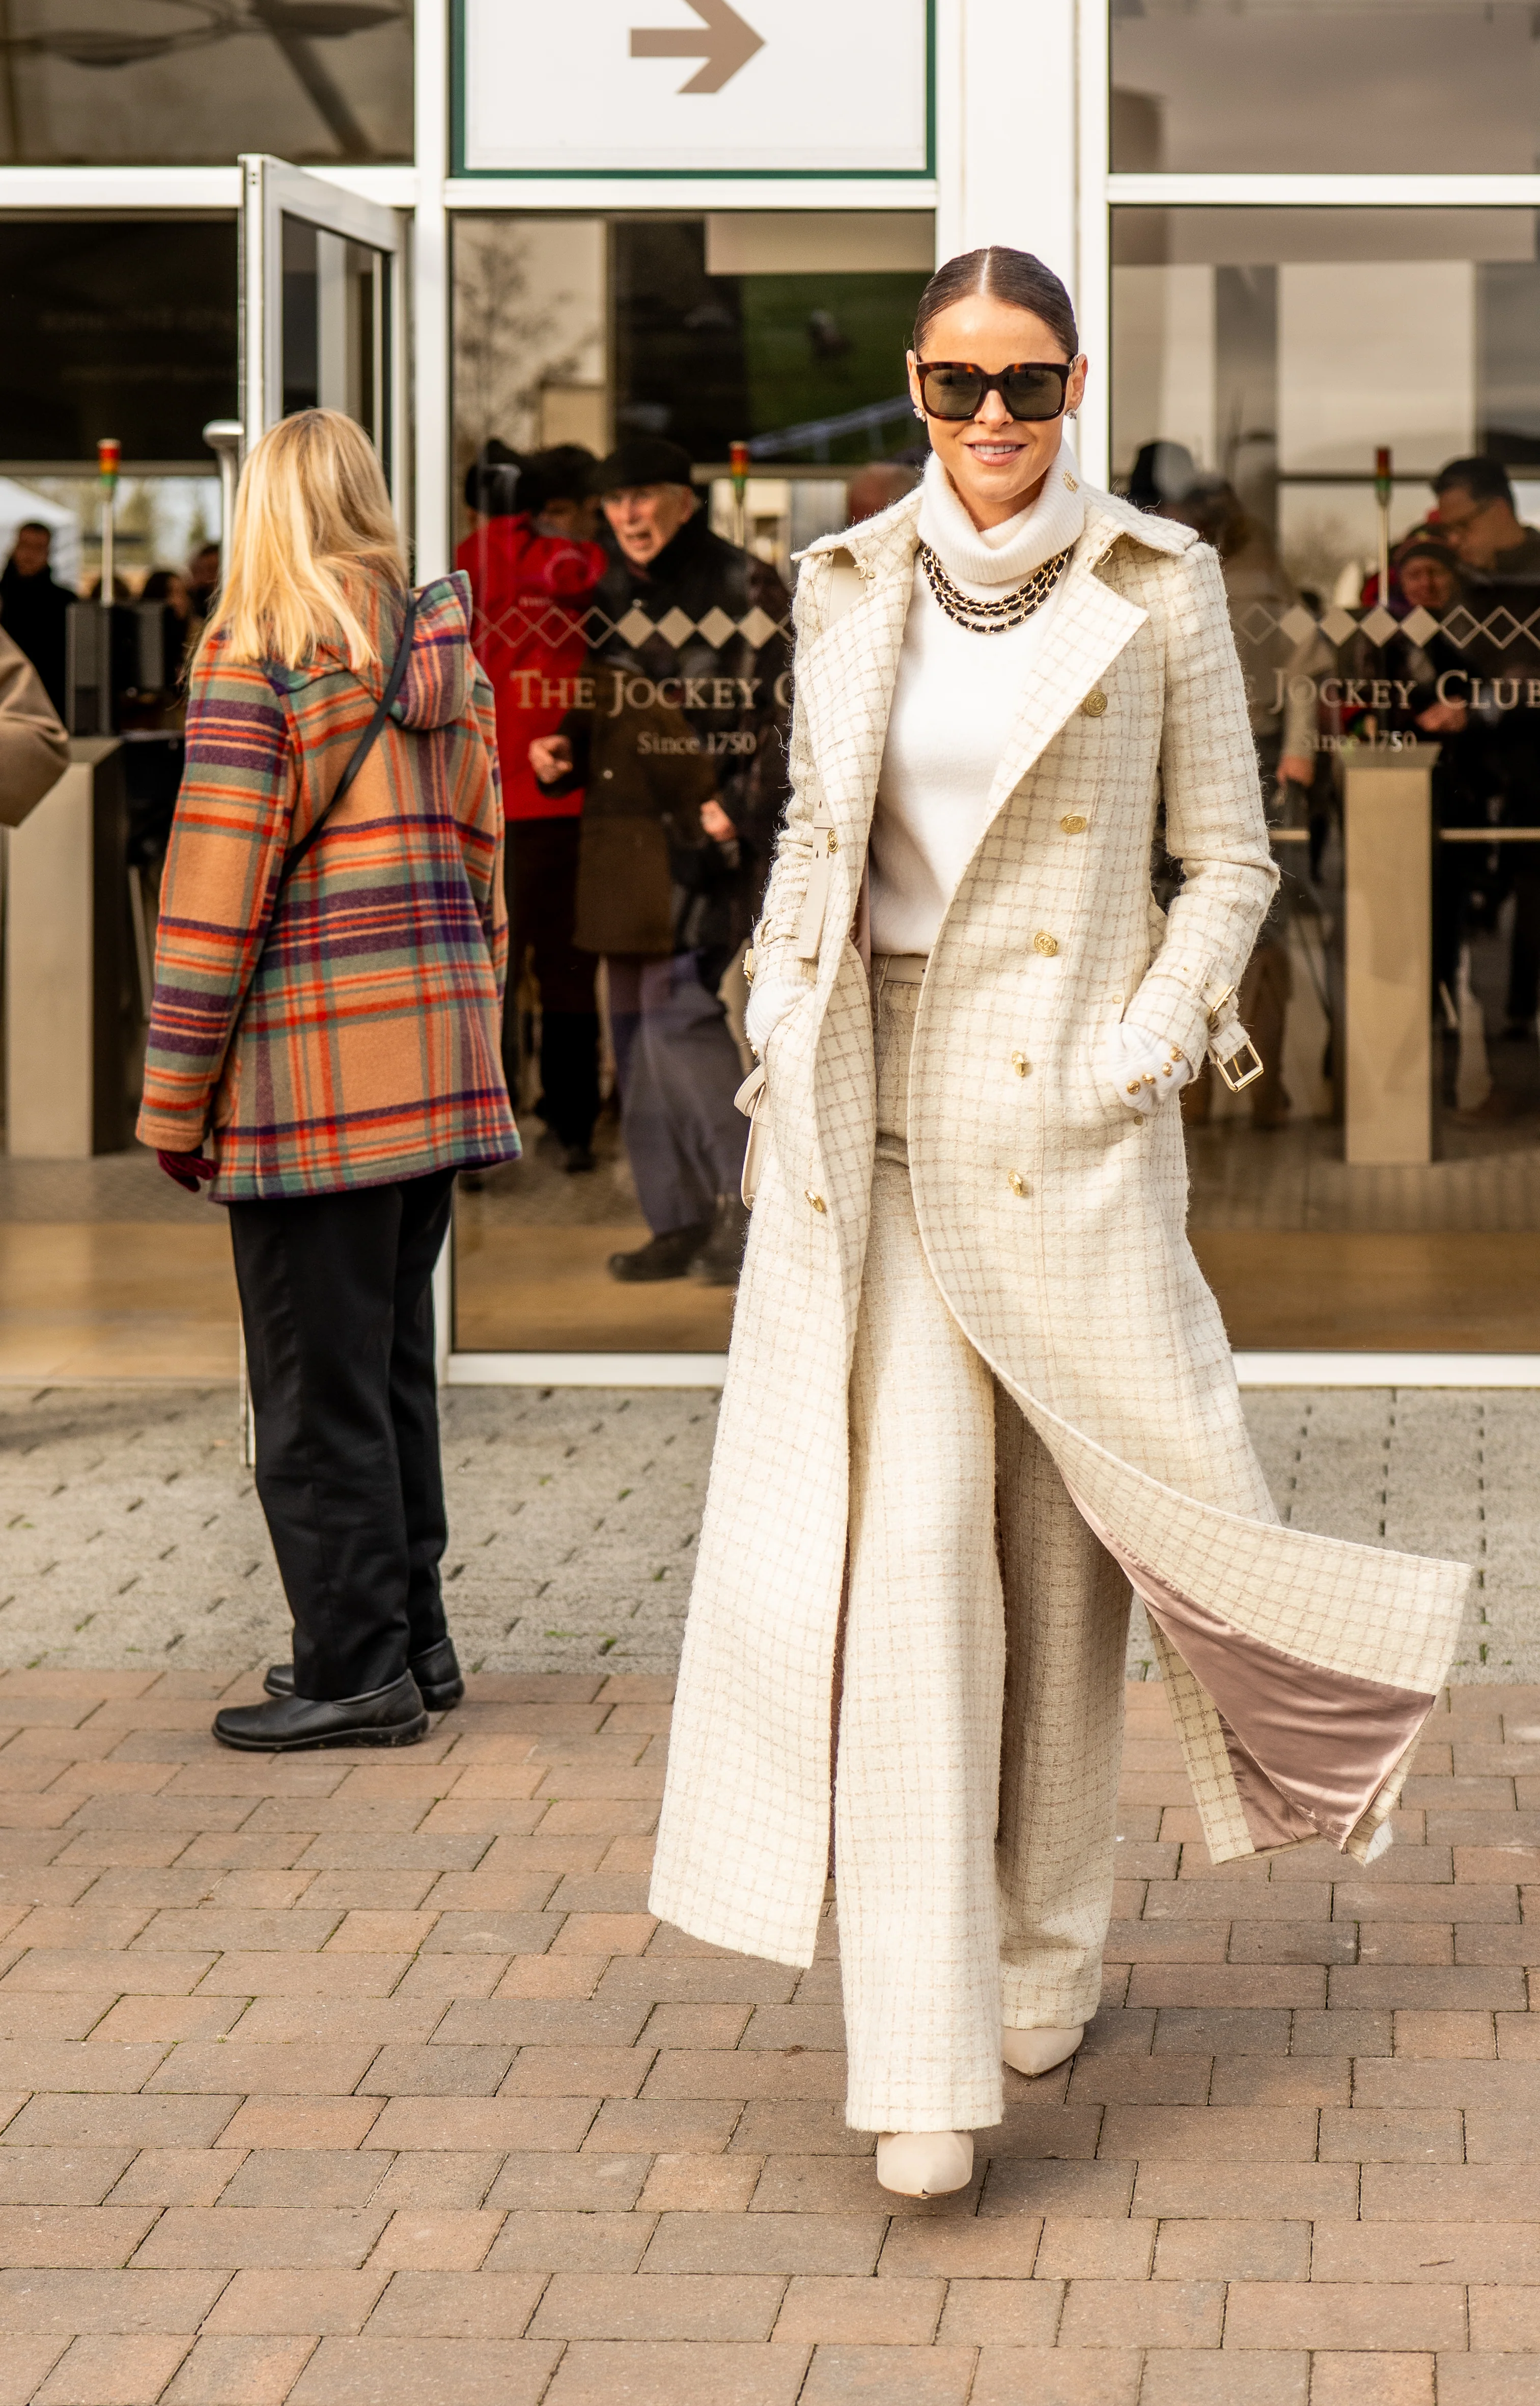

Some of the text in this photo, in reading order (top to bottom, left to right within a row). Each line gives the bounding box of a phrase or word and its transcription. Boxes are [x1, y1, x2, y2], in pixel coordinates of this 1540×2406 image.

[636, 731, 757, 755] Since 1750
[1368, 729, 1418, 753] 1750
